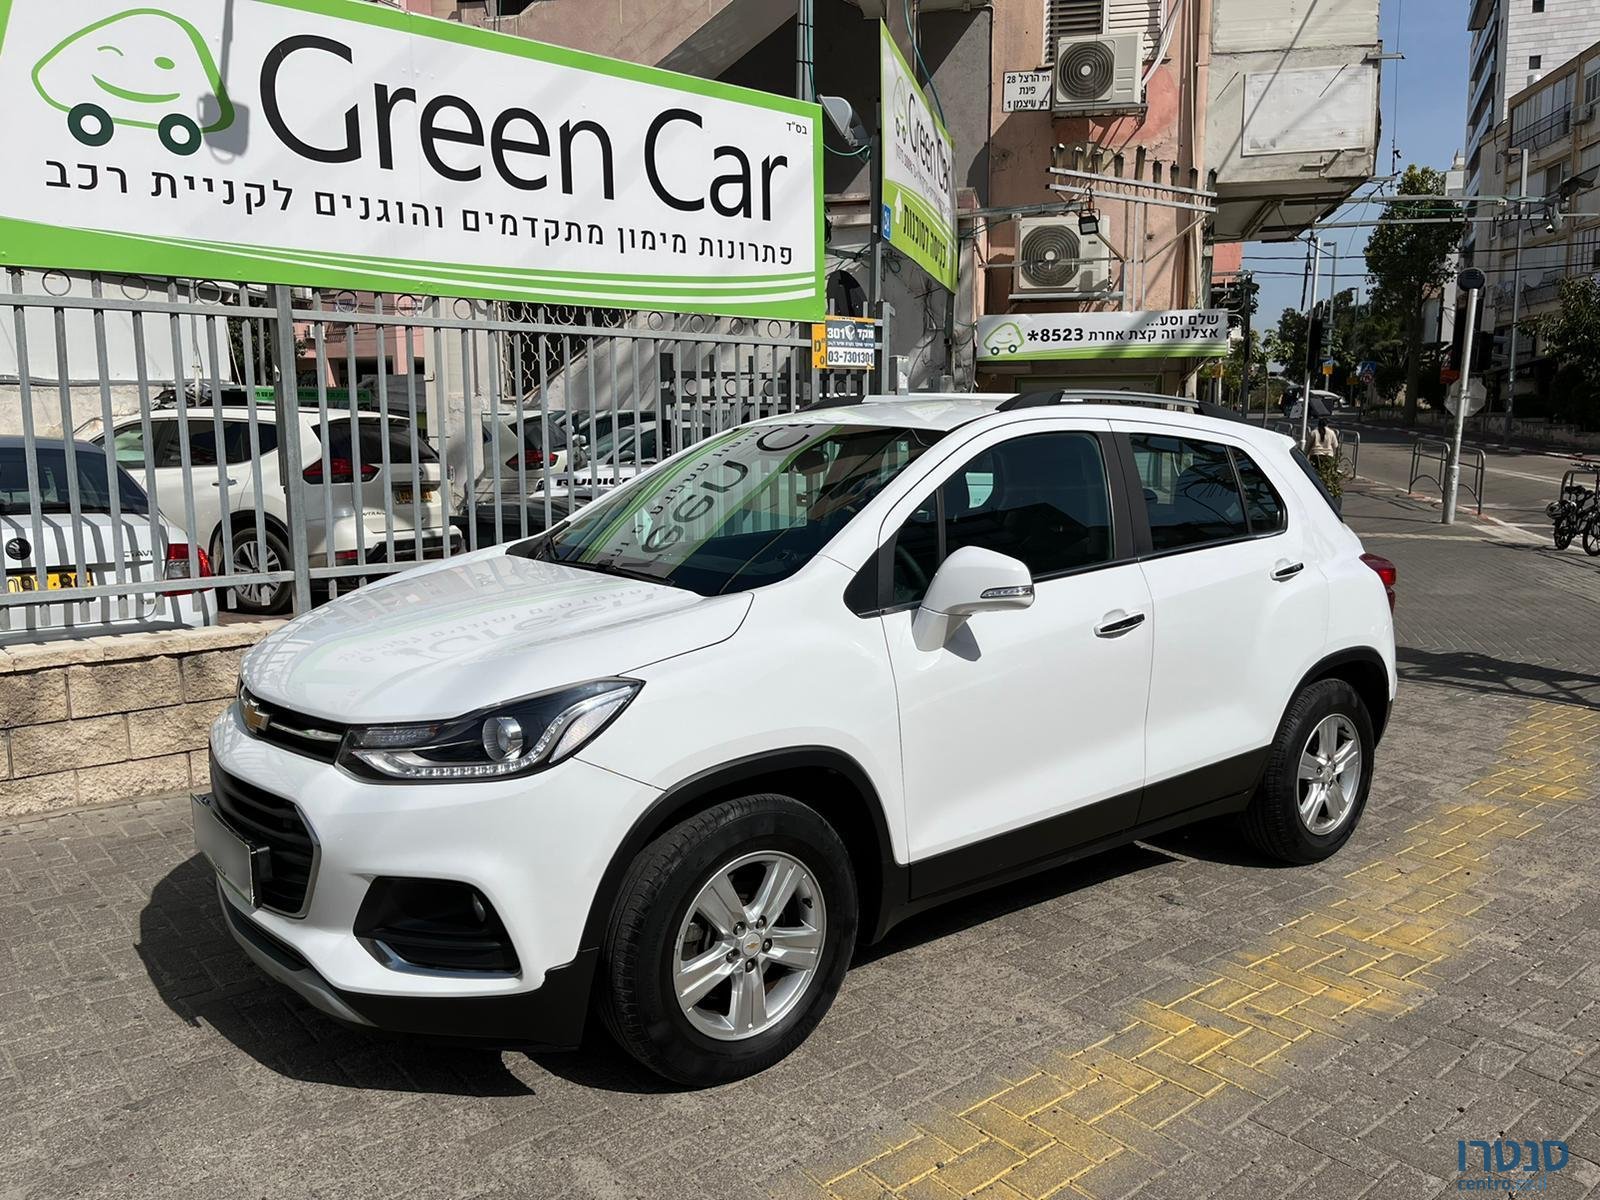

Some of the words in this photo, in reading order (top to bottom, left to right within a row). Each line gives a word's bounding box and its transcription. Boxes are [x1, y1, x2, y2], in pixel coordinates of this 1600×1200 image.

[1006, 75, 1016, 84] 28
[1018, 73, 1039, 83] הרצל
[1019, 86, 1036, 95] פינת
[258, 34, 615, 201] Green
[643, 107, 789, 222] Car
[786, 121, 807, 135] בס"ד
[908, 92, 936, 181] Green
[45, 160, 128, 193] רכב
[151, 171, 293, 215] לקניית
[314, 191, 443, 228] והוגנים
[462, 208, 604, 246] מתקדמים
[617, 227, 687, 254] מימון
[699, 236, 793, 265] פתרונות
[1188, 313, 1219, 325] שלם
[1088, 330, 1124, 342] אחרת
[1128, 329, 1156, 342] קצת
[1161, 328, 1175, 340] זה
[1181, 326, 1218, 339] אצלנו
[828, 350, 874, 364] 03-7301301
